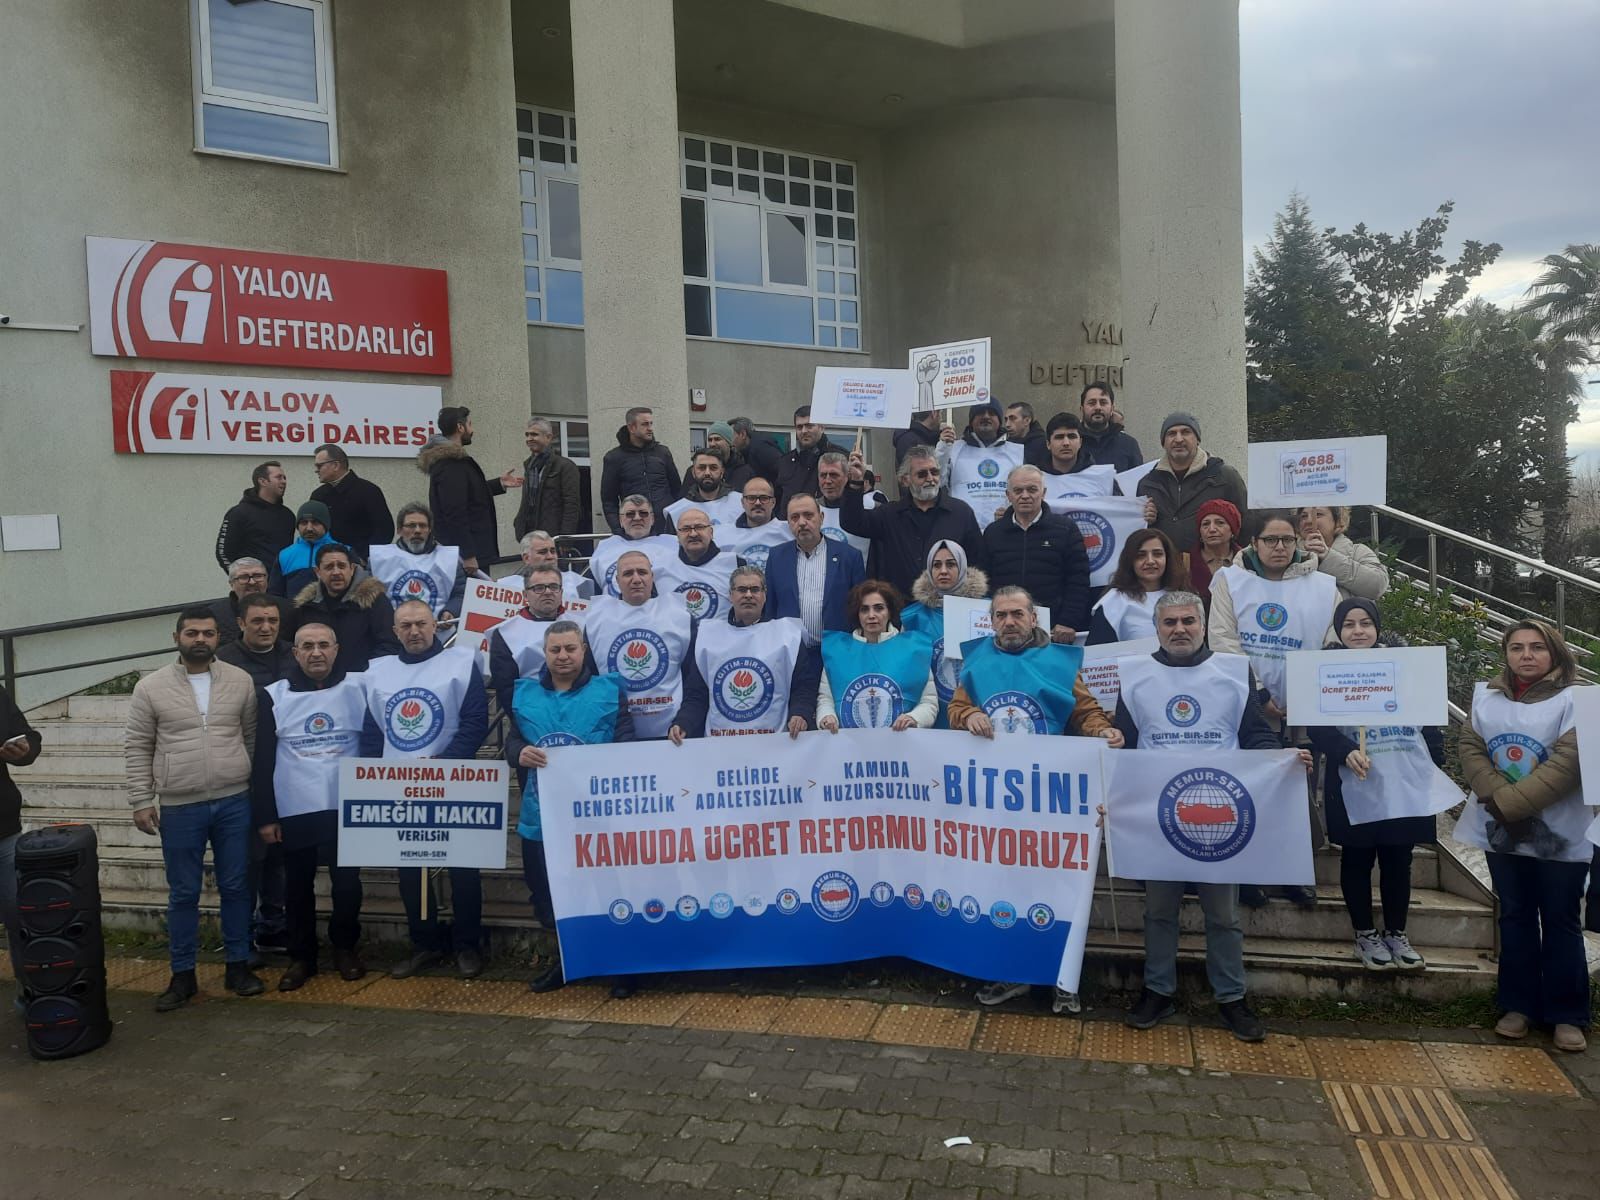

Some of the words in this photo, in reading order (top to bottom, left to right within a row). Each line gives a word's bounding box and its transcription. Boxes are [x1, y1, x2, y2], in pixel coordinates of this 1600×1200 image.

[231, 265, 334, 302] YALOVA
[237, 315, 434, 357] DEFTERDARLIĞI
[1081, 320, 1123, 346] YAL
[943, 355, 975, 369] 3600
[944, 374, 975, 386] HEMEN
[1029, 363, 1123, 388] DEFTER
[220, 389, 339, 414] YALOVA
[943, 383, 975, 400] ŞİMDİ!
[222, 416, 315, 444] VERGİ
[323, 417, 435, 446] DAİRESİ
[1298, 453, 1335, 467] 4688
[1239, 632, 1258, 644] TOÇ
[1259, 633, 1303, 650] BİR-SEN
[1322, 686, 1349, 694] ÜCRET
[1351, 685, 1393, 693] REFORMU
[356, 766, 445, 783] DAYANIŞMA
[450, 765, 499, 783] AİDATI
[717, 765, 780, 788] GELİRDE
[844, 761, 910, 779] KAMUDA
[404, 786, 445, 799] GELSİN
[590, 774, 657, 796] ÜCRETTE
[823, 782, 931, 803] HUZURSUZLUK
[943, 759, 1089, 816] BİTSİN!
[1166, 771, 1244, 800] MEMUR-SEN
[573, 794, 675, 818] DENGESİZLİK
[695, 784, 803, 811] ADALETSİZLİK
[350, 800, 428, 825] EMEĞİN
[434, 804, 496, 825] HAKKI
[397, 829, 449, 842] VERİLSİN
[575, 827, 697, 868] KAMUDA
[704, 820, 791, 862] ÜCRET
[798, 814, 927, 855] REFORMU
[934, 818, 1089, 871] İSTİYORUZ!
[400, 850, 447, 858] MEMUR-SEN
